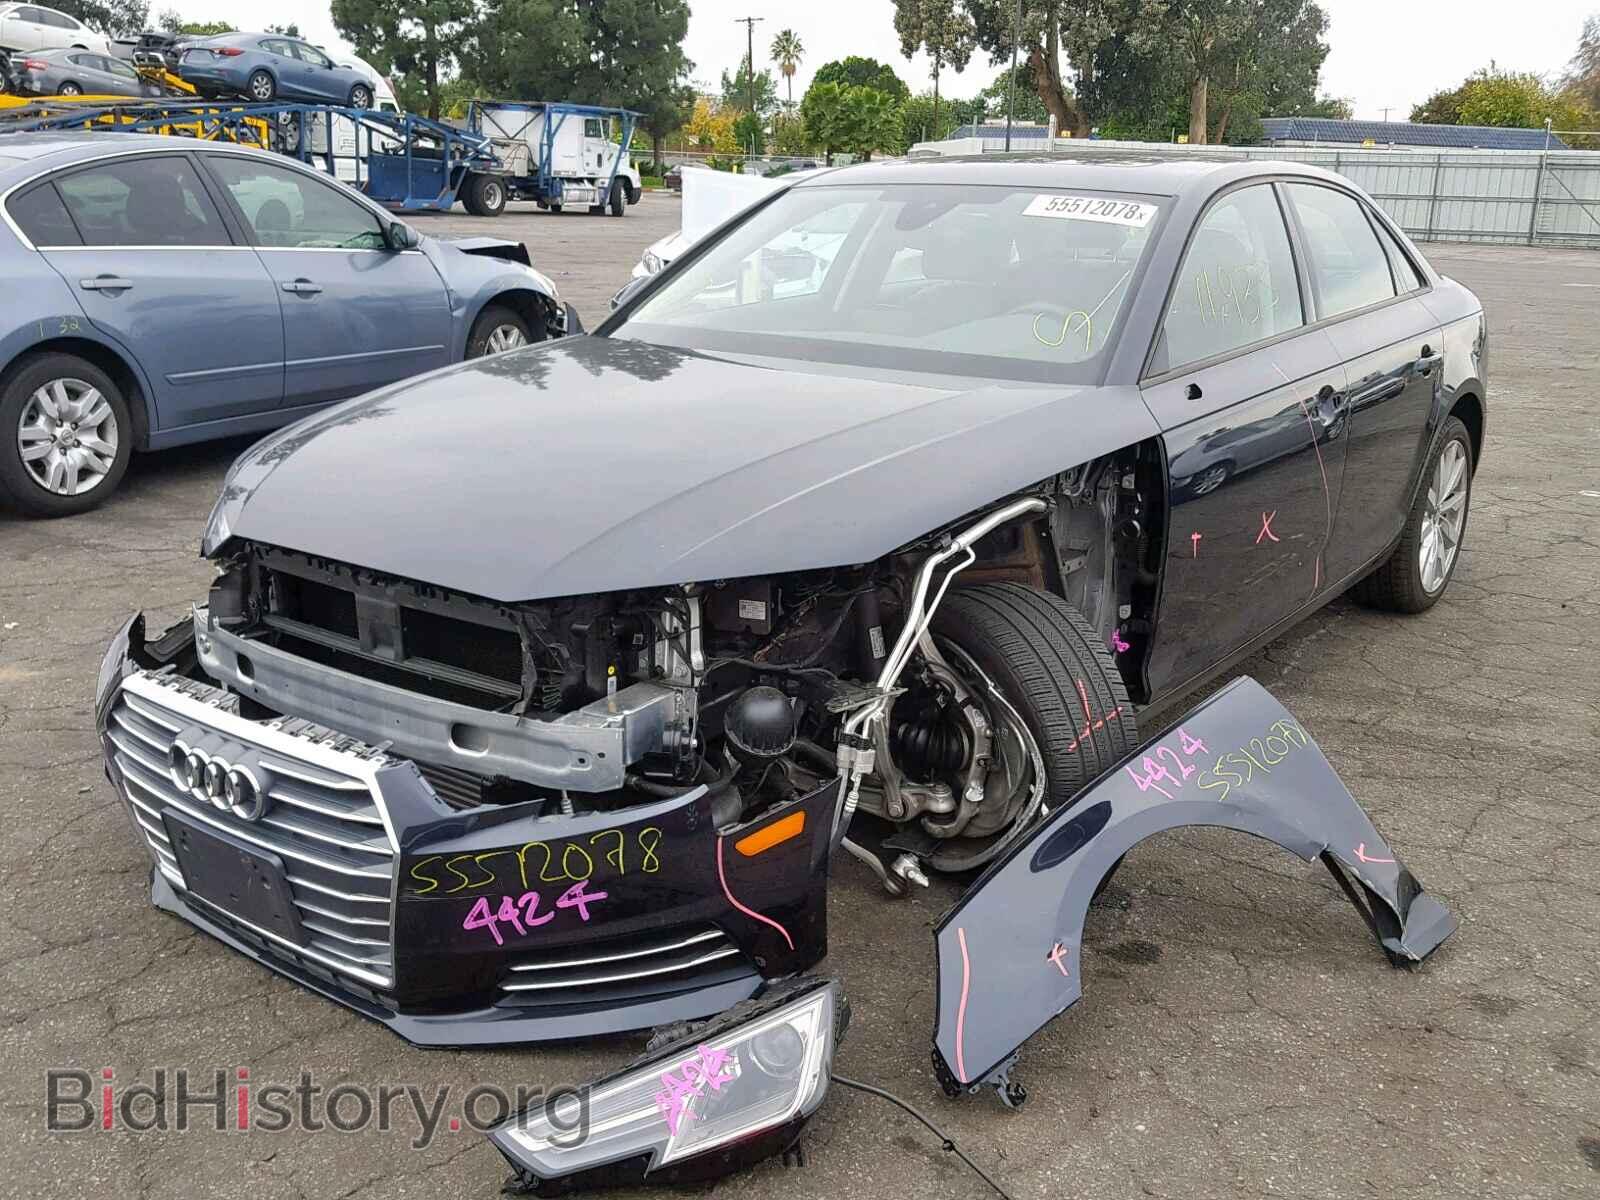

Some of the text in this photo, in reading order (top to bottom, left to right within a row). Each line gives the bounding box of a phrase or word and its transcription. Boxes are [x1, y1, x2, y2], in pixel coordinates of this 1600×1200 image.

[1125, 727, 1209, 800] 4424
[410, 827, 663, 894] 55512078
[463, 879, 609, 946] 4424
